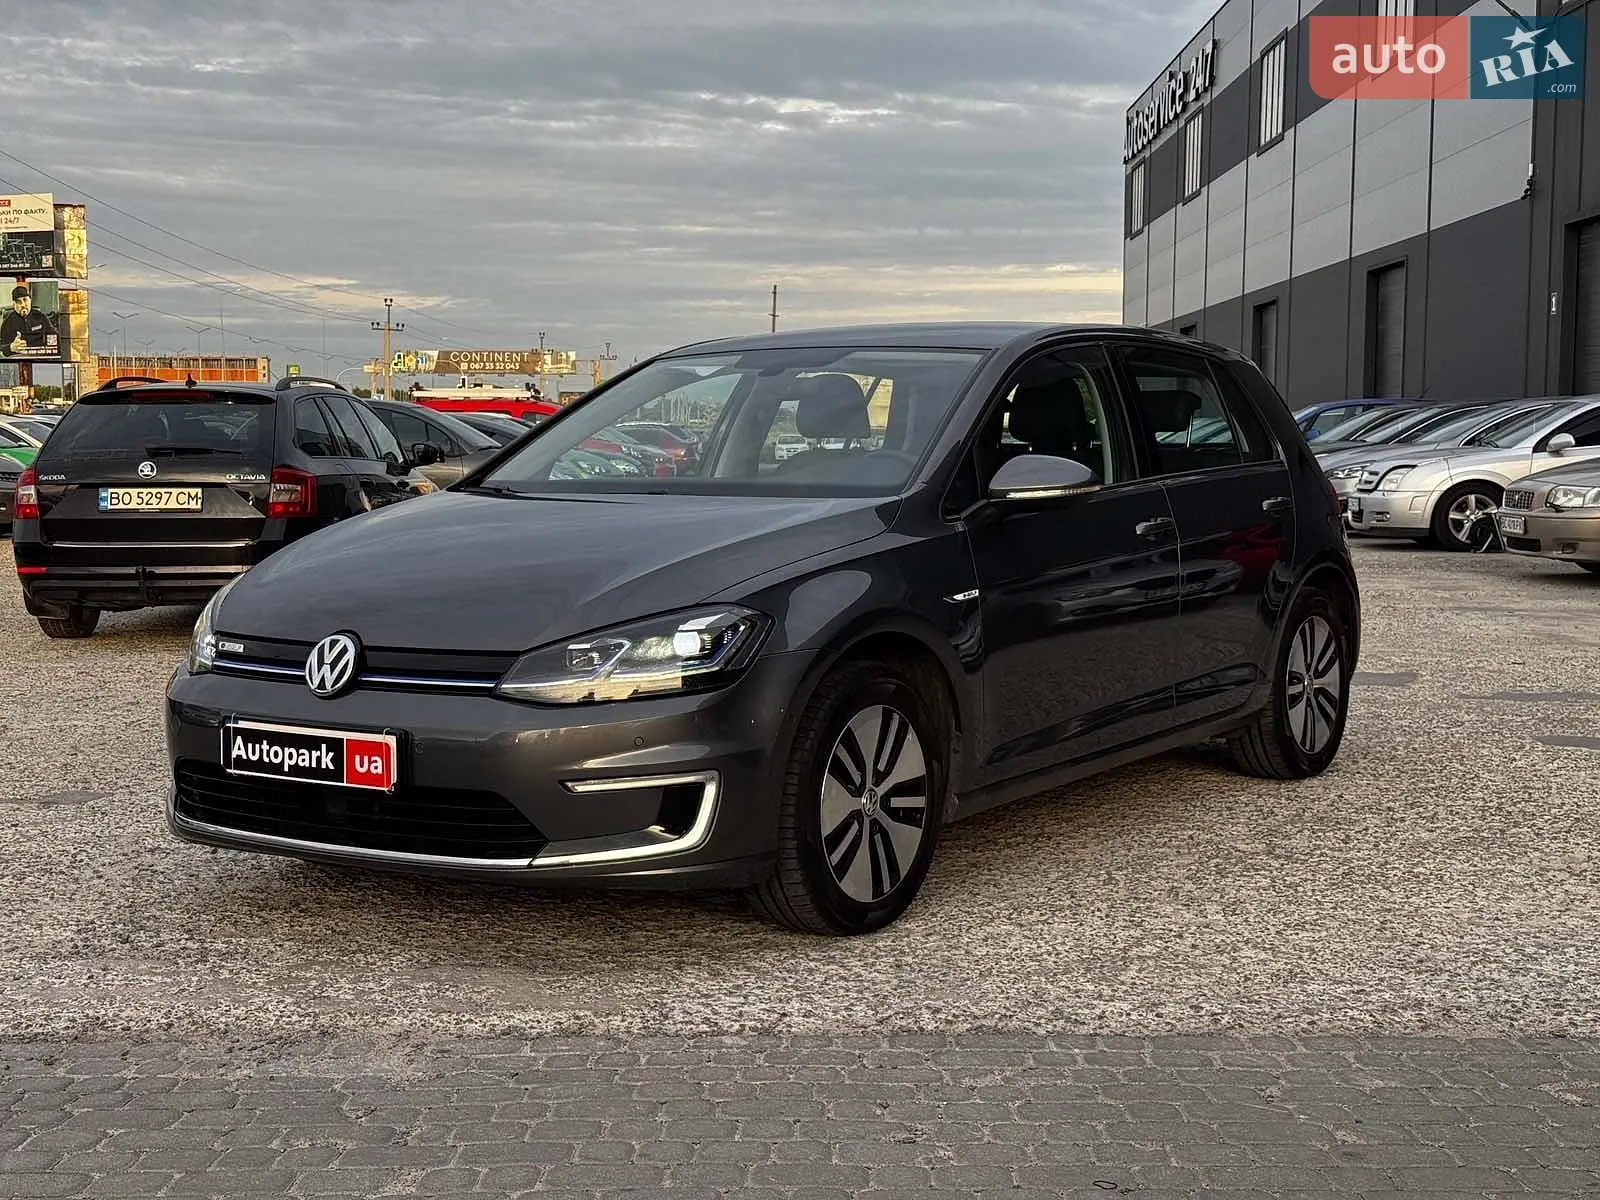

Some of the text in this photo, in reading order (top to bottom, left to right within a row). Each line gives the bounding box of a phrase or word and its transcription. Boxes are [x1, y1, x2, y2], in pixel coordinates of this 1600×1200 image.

[1190, 40, 1214, 103] 24/7
[450, 351, 529, 362] CONTINENT
[225, 473, 266, 481] OCTAVIA
[110, 491, 199, 506] BO 5297 CM
[232, 735, 384, 775] Autopark ua
